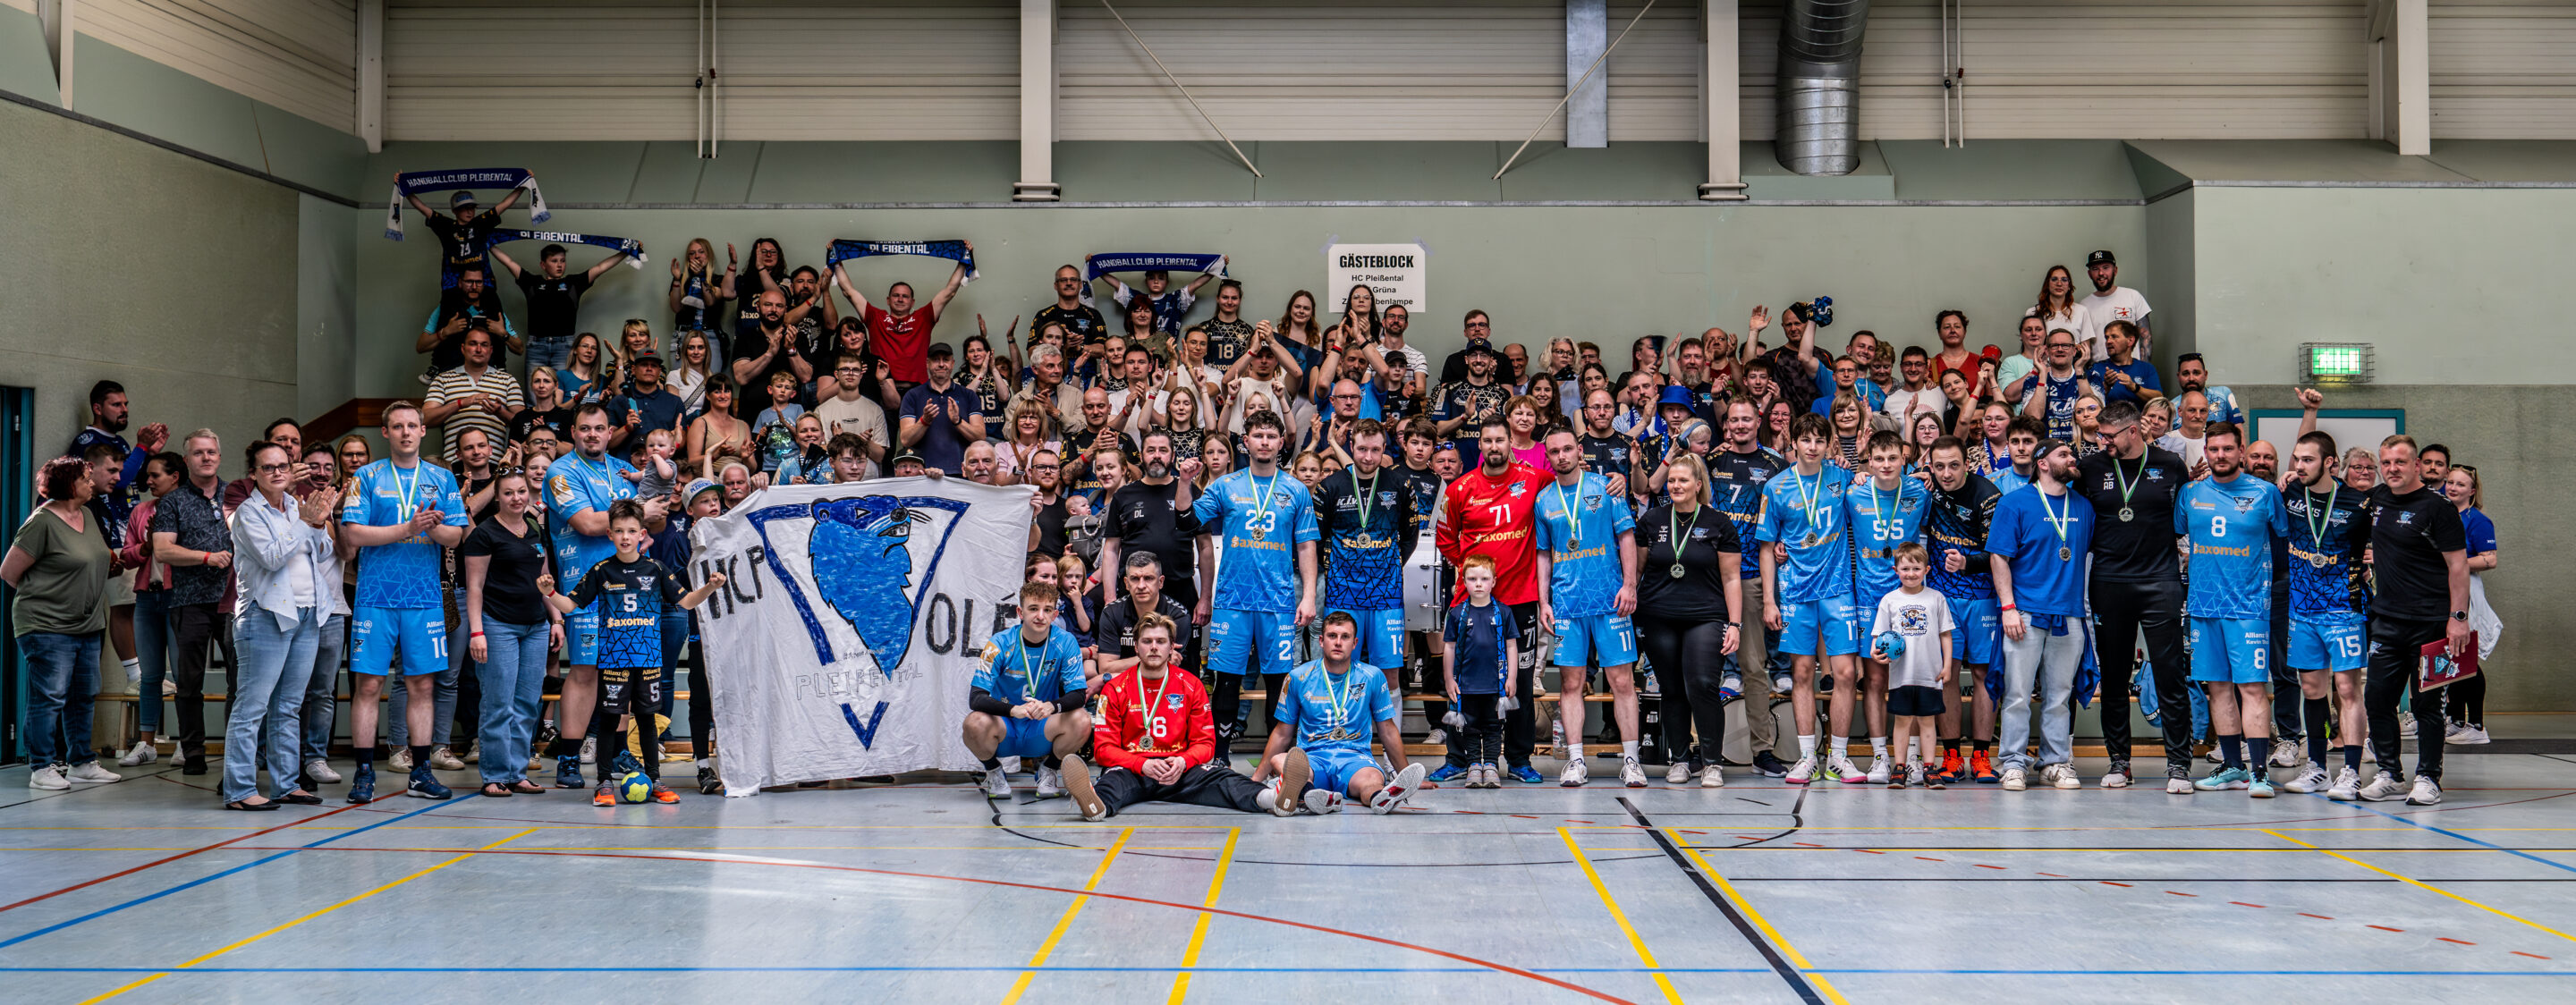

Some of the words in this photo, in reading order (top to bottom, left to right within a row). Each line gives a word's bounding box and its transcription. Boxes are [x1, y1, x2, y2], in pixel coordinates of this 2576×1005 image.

[407, 174, 467, 187] HANDBALLCLUB
[1097, 258, 1155, 268] HANDBALLCLUB
[1339, 253, 1414, 267] GÄSTEBLOCK
[1217, 343, 1234, 359] 18
[979, 394, 996, 410] 15
[1729, 484, 1742, 503] 7
[2104, 481, 2114, 491] AB
[1134, 510, 1144, 519] DL
[1245, 509, 1275, 532] 23
[1488, 503, 1512, 527] 71
[1816, 505, 1832, 529] 17
[1873, 519, 1904, 541] 55
[2211, 516, 2226, 537] 8
[700, 545, 766, 620] HCP
[623, 594, 638, 612] 5
[1523, 627, 1536, 648] 71
[1619, 630, 1632, 652] 11
[2336, 635, 2362, 658] 15
[2254, 647, 2266, 669] 8
[649, 682, 660, 703] 5
